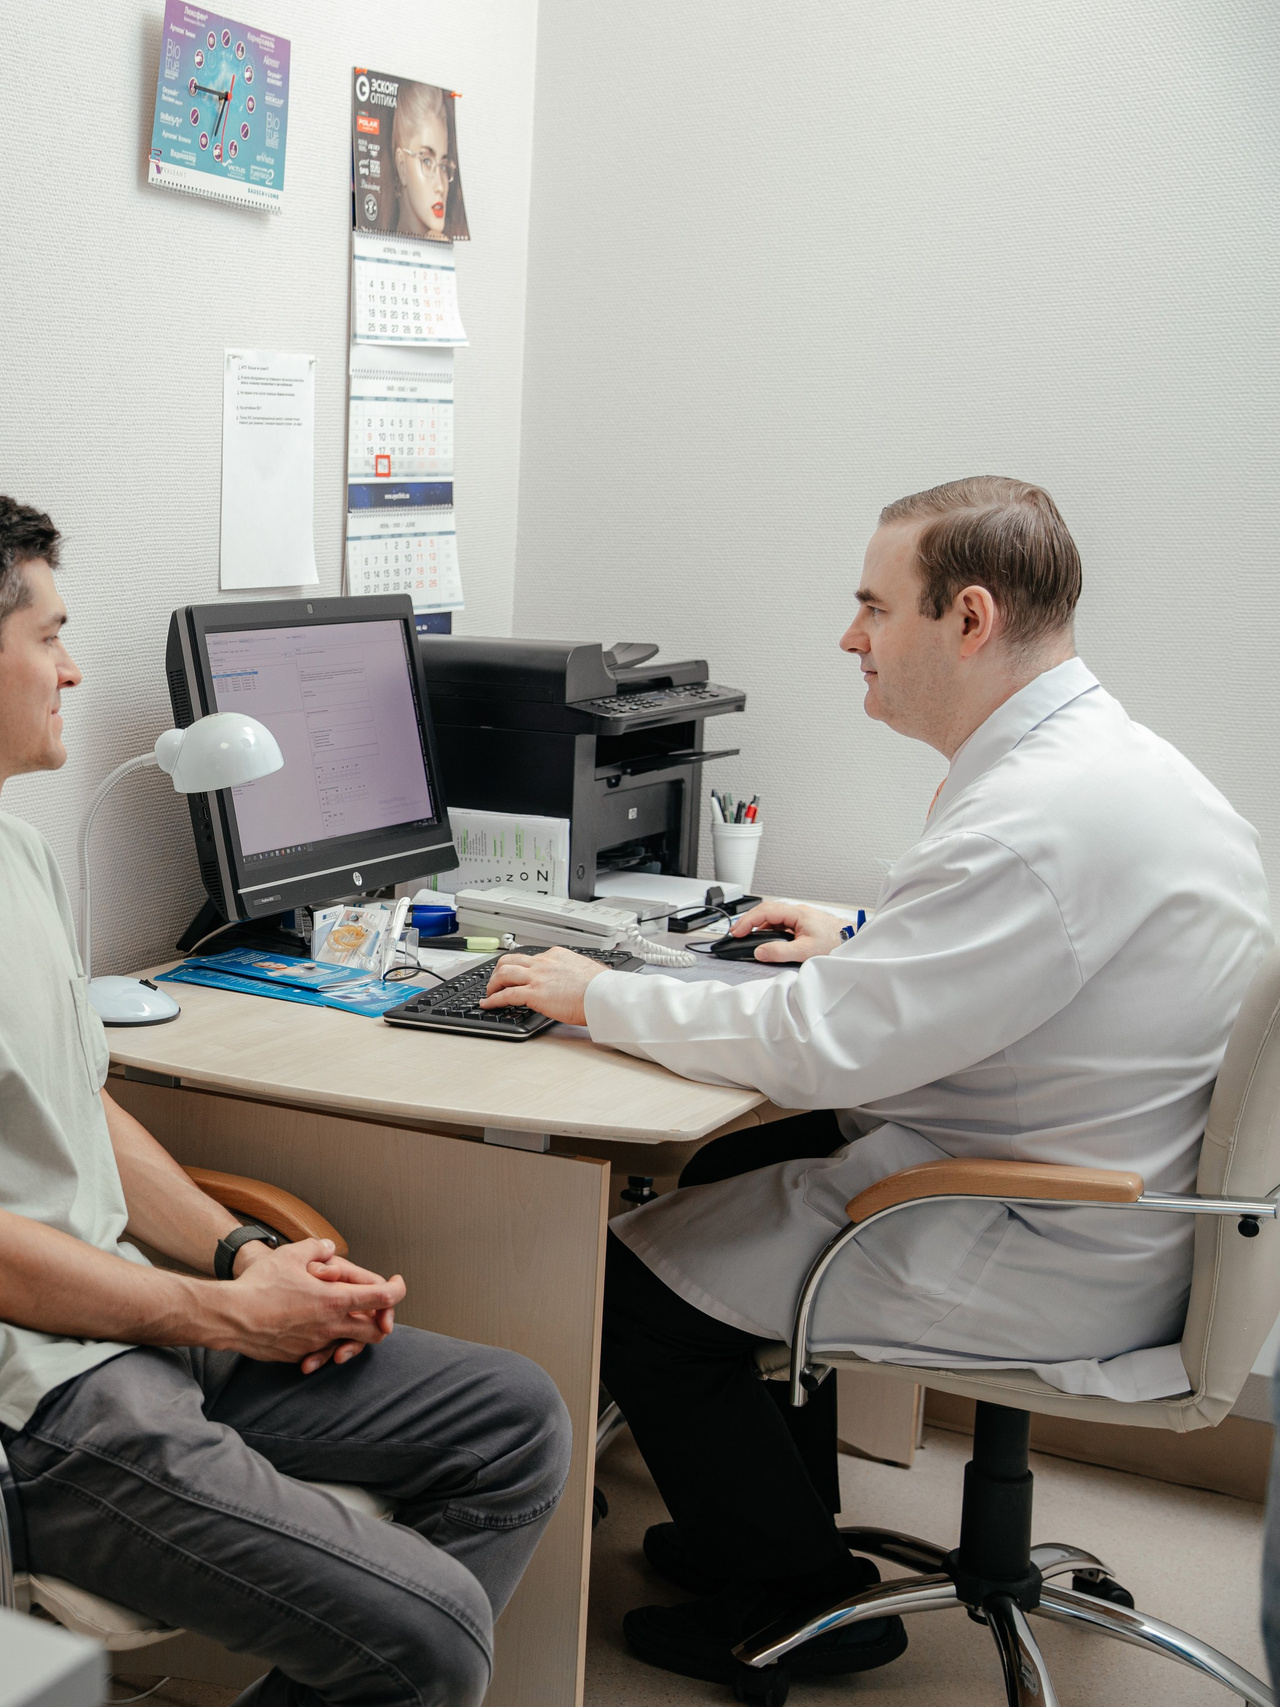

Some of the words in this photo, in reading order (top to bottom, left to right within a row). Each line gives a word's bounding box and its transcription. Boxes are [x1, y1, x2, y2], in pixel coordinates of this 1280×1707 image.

[167, 39, 180, 59] Bio
[165, 57, 180, 72] true
[371, 79, 399, 96] ЭСКОНТ
[370, 92, 397, 108] ОПТИКА
[266, 111, 280, 131] Bio
[358, 118, 378, 128] POLAR
[266, 128, 279, 142] true
[163, 167, 187, 178] VALEANT
[248, 188, 265, 196] BAUSCH
[268, 192, 279, 200] LOMB
[368, 294, 375, 303] 11
[379, 295, 387, 305] 12
[390, 296, 398, 306] 13
[401, 297, 409, 306] 14
[390, 310, 399, 320] 20
[401, 311, 409, 320] 21
[412, 312, 421, 321] 22
[367, 322, 376, 332] 25
[379, 323, 388, 333] 26
[391, 324, 399, 334] 27
[367, 418, 372, 428] 2
[379, 418, 384, 428] 3
[378, 432, 386, 442] 10
[389, 433, 395, 441] 11
[398, 433, 404, 442] 12
[407, 433, 415, 442] 13
[366, 446, 375, 456] 16
[406, 447, 414, 456] 20
[394, 541, 399, 550] 2
[405, 540, 410, 550] 3
[404, 554, 412, 563] 10
[363, 571, 371, 580] 13
[373, 570, 380, 579] 14
[383, 569, 390, 578] 15
[404, 567, 412, 576] 17
[382, 583, 390, 592] 22
[392, 582, 400, 591] 23
[403, 581, 412, 590] 24
[416, 580, 424, 589] 25
